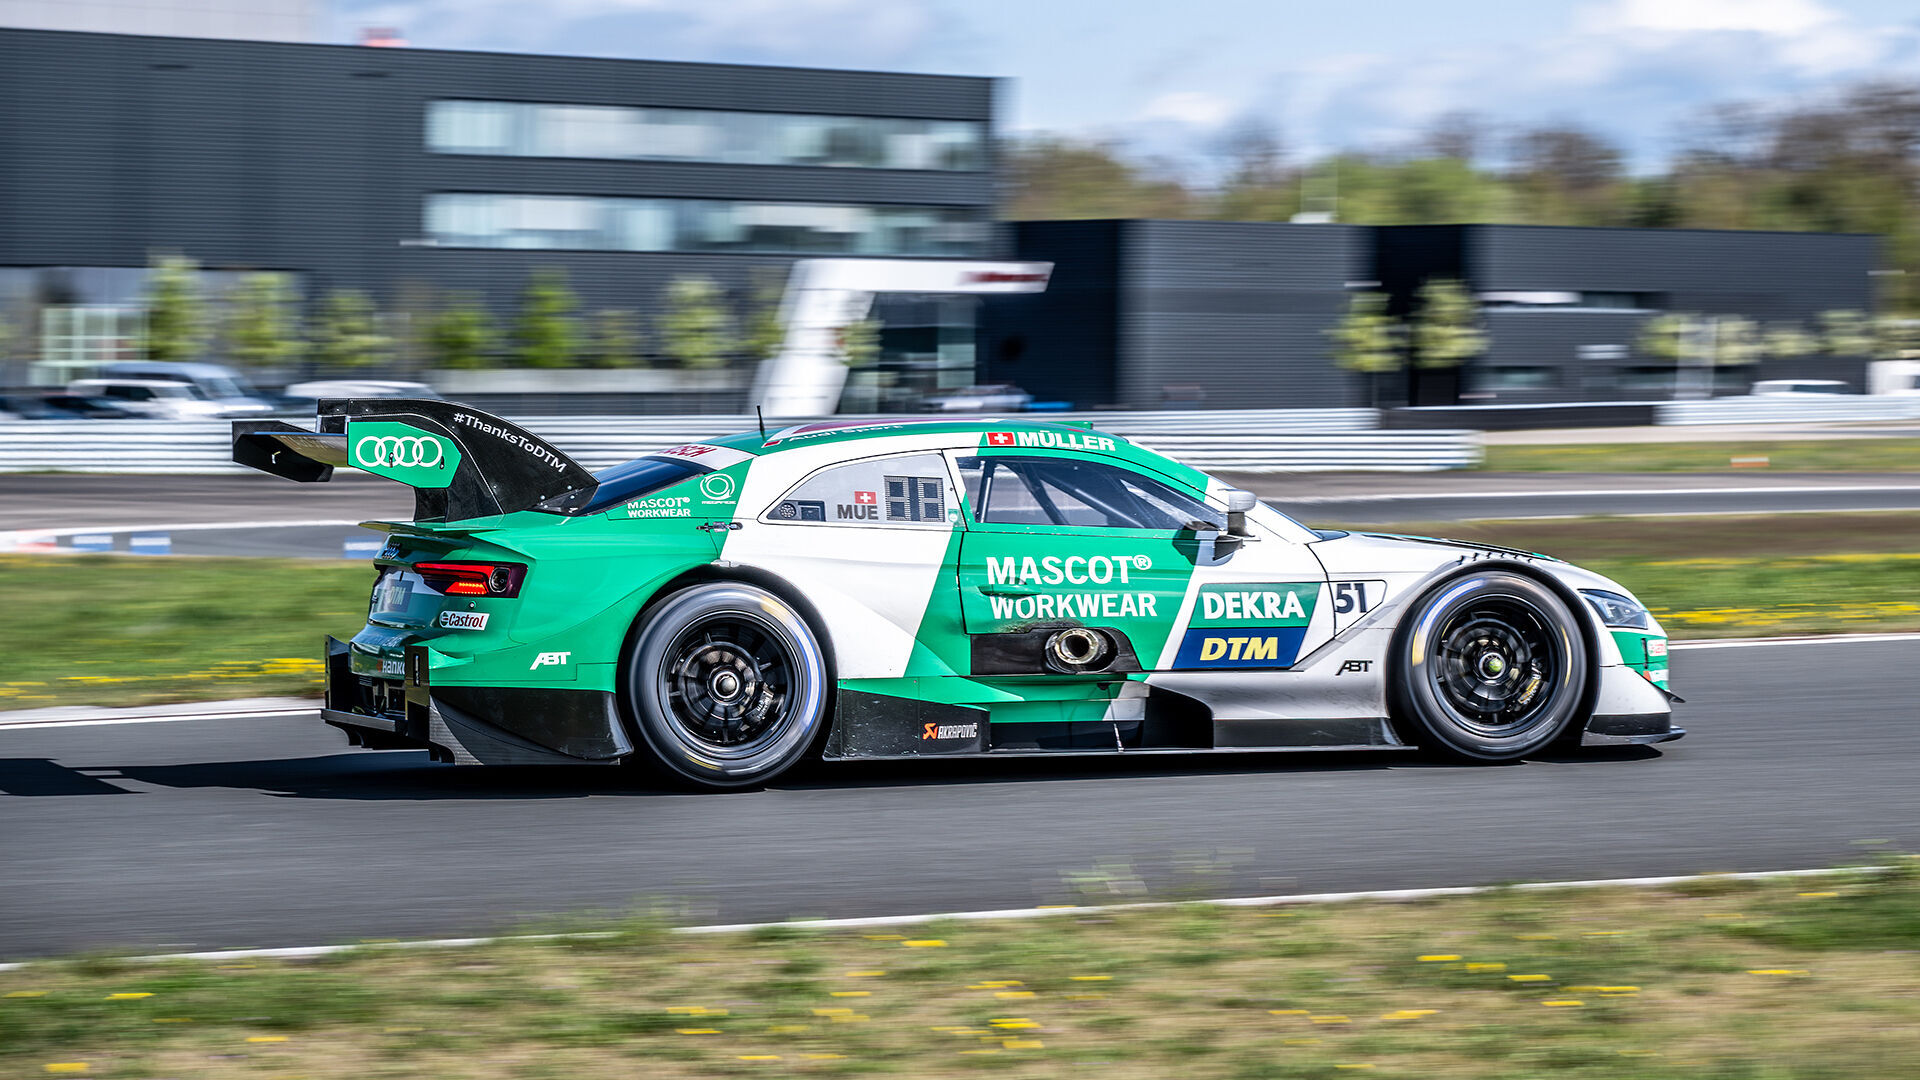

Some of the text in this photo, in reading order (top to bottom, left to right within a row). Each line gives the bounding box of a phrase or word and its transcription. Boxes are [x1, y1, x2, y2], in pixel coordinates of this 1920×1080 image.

[453, 412, 567, 473] #ThanksToDTM
[1017, 430, 1116, 451] MÜLLER
[627, 508, 691, 518] WORKWEAR
[837, 504, 879, 520] MUE
[986, 554, 1153, 585] MASCOT®
[989, 593, 1158, 619] WORKWEAR
[1202, 591, 1307, 620] DEKRA
[1334, 583, 1368, 614] 51
[448, 613, 485, 628] Castrol
[1199, 637, 1279, 661] DTM
[529, 651, 571, 670] ABT
[1335, 660, 1373, 676] ABT
